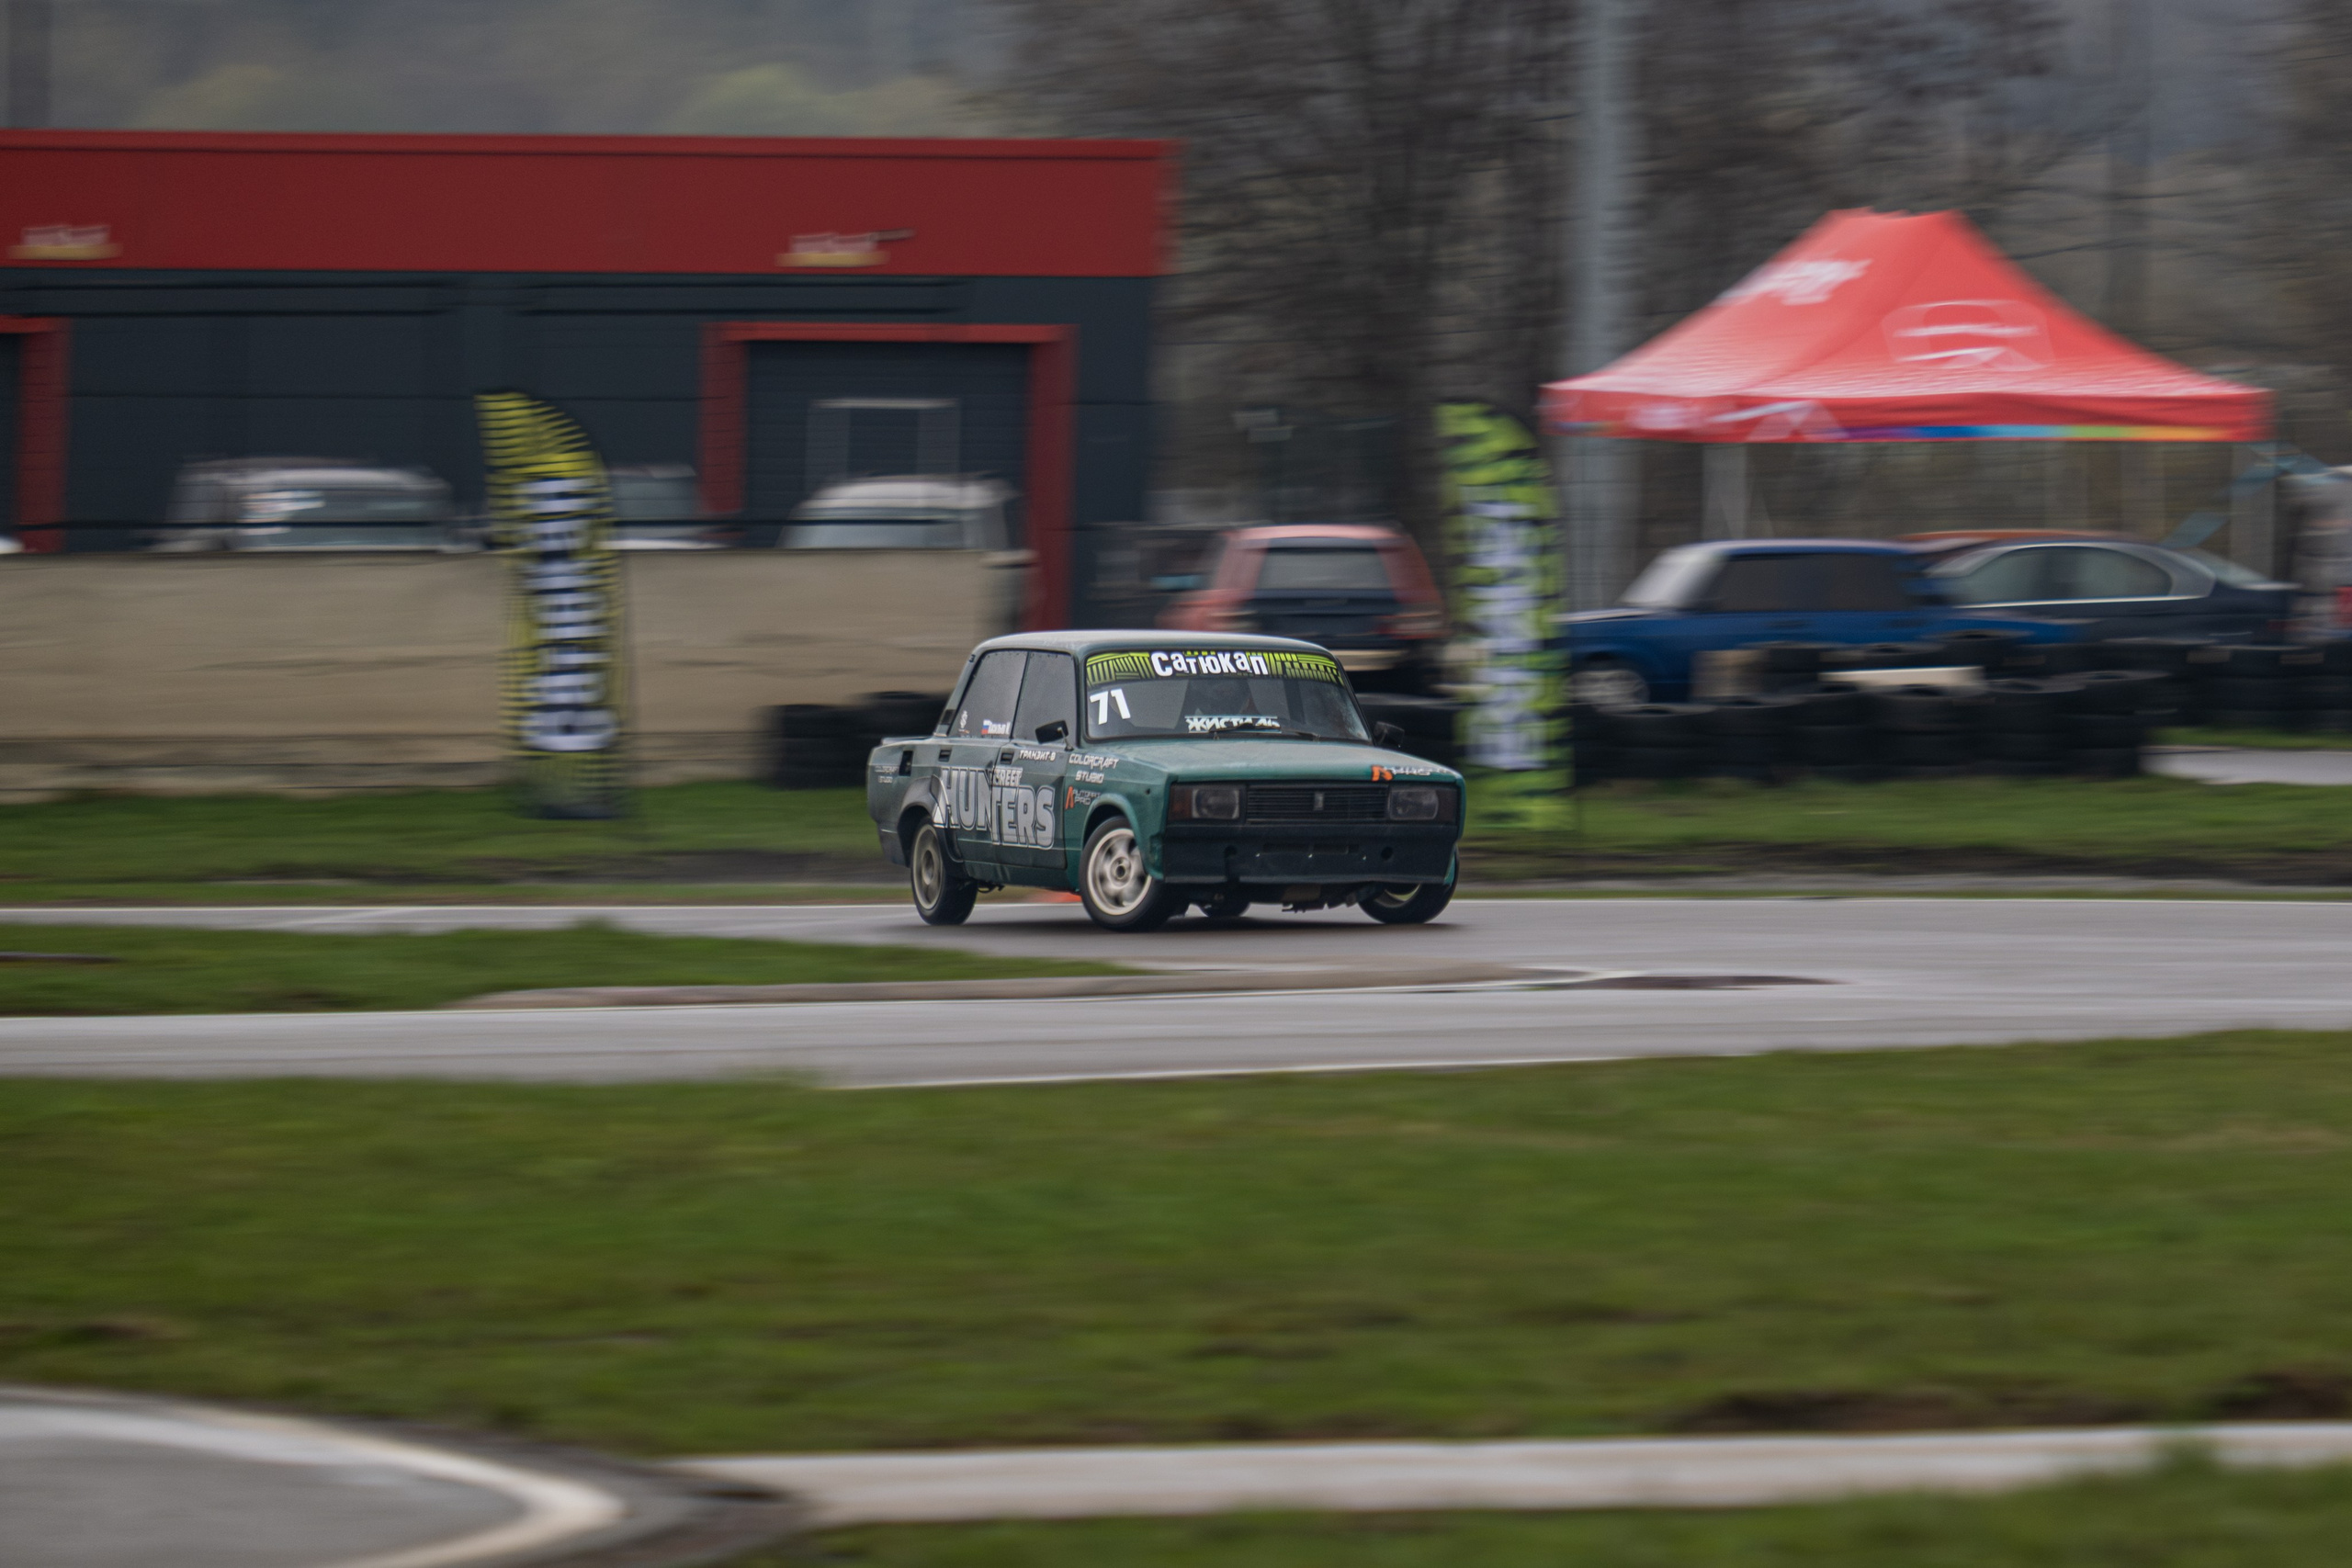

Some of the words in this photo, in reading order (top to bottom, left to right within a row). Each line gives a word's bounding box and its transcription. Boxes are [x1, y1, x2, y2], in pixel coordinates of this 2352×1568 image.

[1089, 688, 1131, 725] 71
[1069, 753, 1119, 770] COLORCRAFT
[1075, 770, 1104, 784] STUDIO
[933, 766, 1056, 850] HUNTERS
